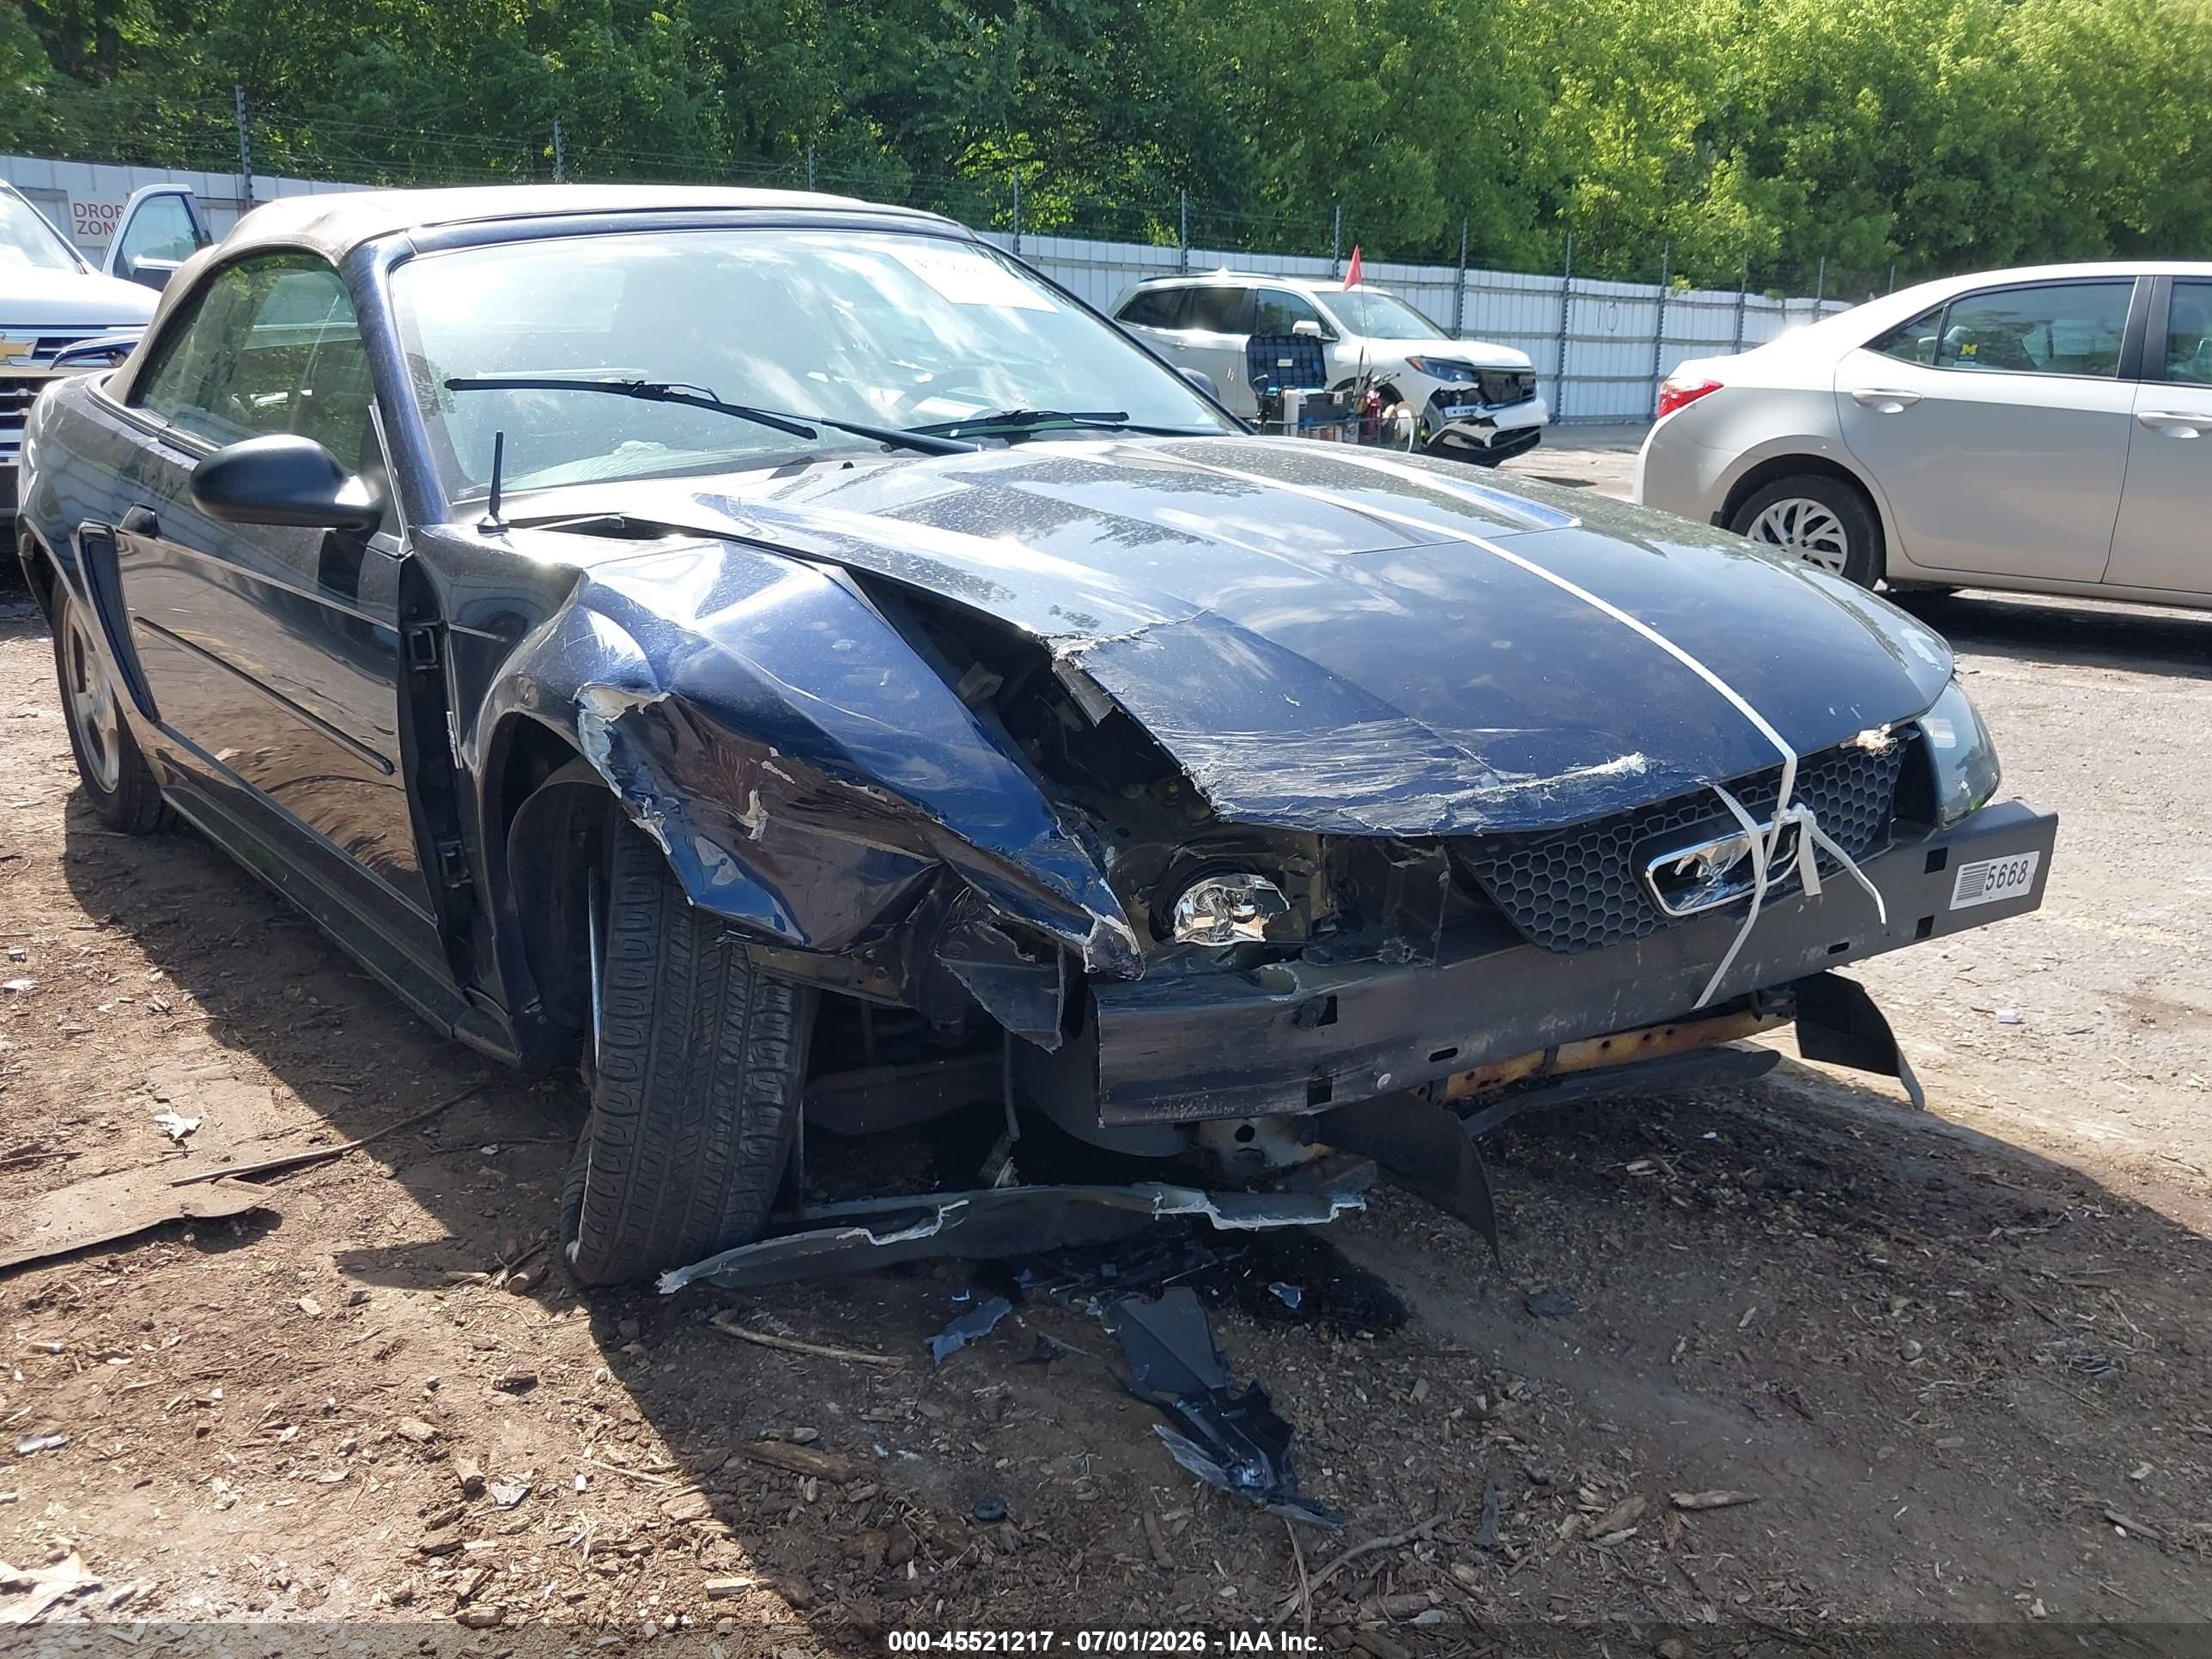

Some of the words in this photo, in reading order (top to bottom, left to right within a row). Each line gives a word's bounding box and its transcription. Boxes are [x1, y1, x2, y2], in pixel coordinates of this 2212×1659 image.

[73, 203, 124, 219] DROP
[76, 220, 116, 235] ZON
[1960, 343, 1978, 356] M
[1985, 860, 2028, 891] 5668
